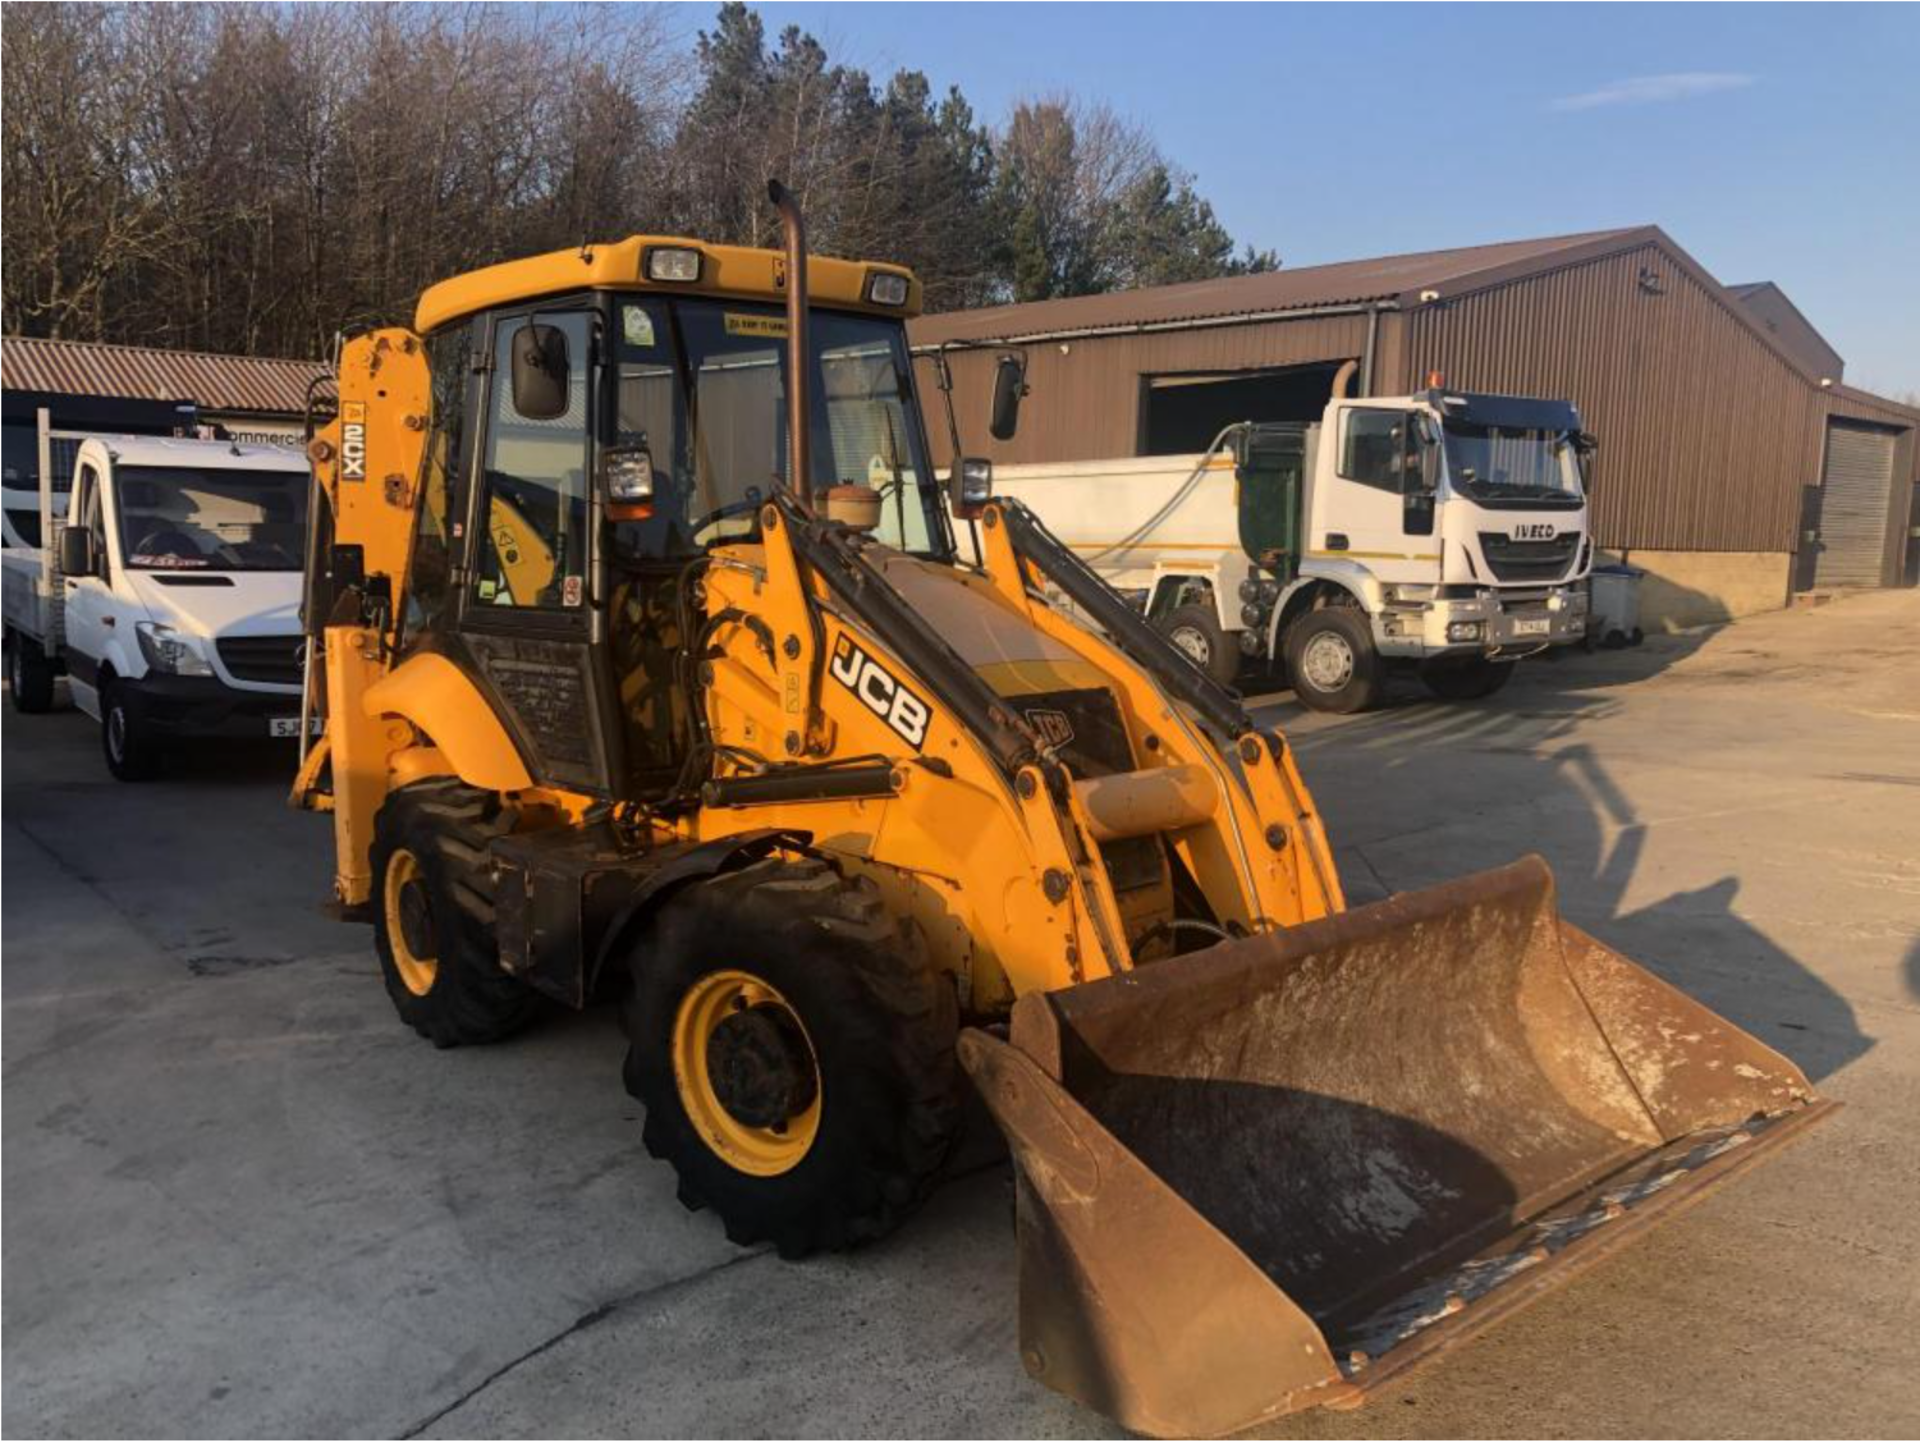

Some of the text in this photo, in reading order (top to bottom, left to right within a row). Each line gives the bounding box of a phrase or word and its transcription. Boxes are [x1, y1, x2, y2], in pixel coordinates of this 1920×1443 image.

[343, 424, 365, 476] 2CX
[1515, 523, 1555, 539] IVECO
[832, 649, 928, 746] JCB
[277, 720, 317, 736] SJ7
[1033, 714, 1070, 744] JCB
